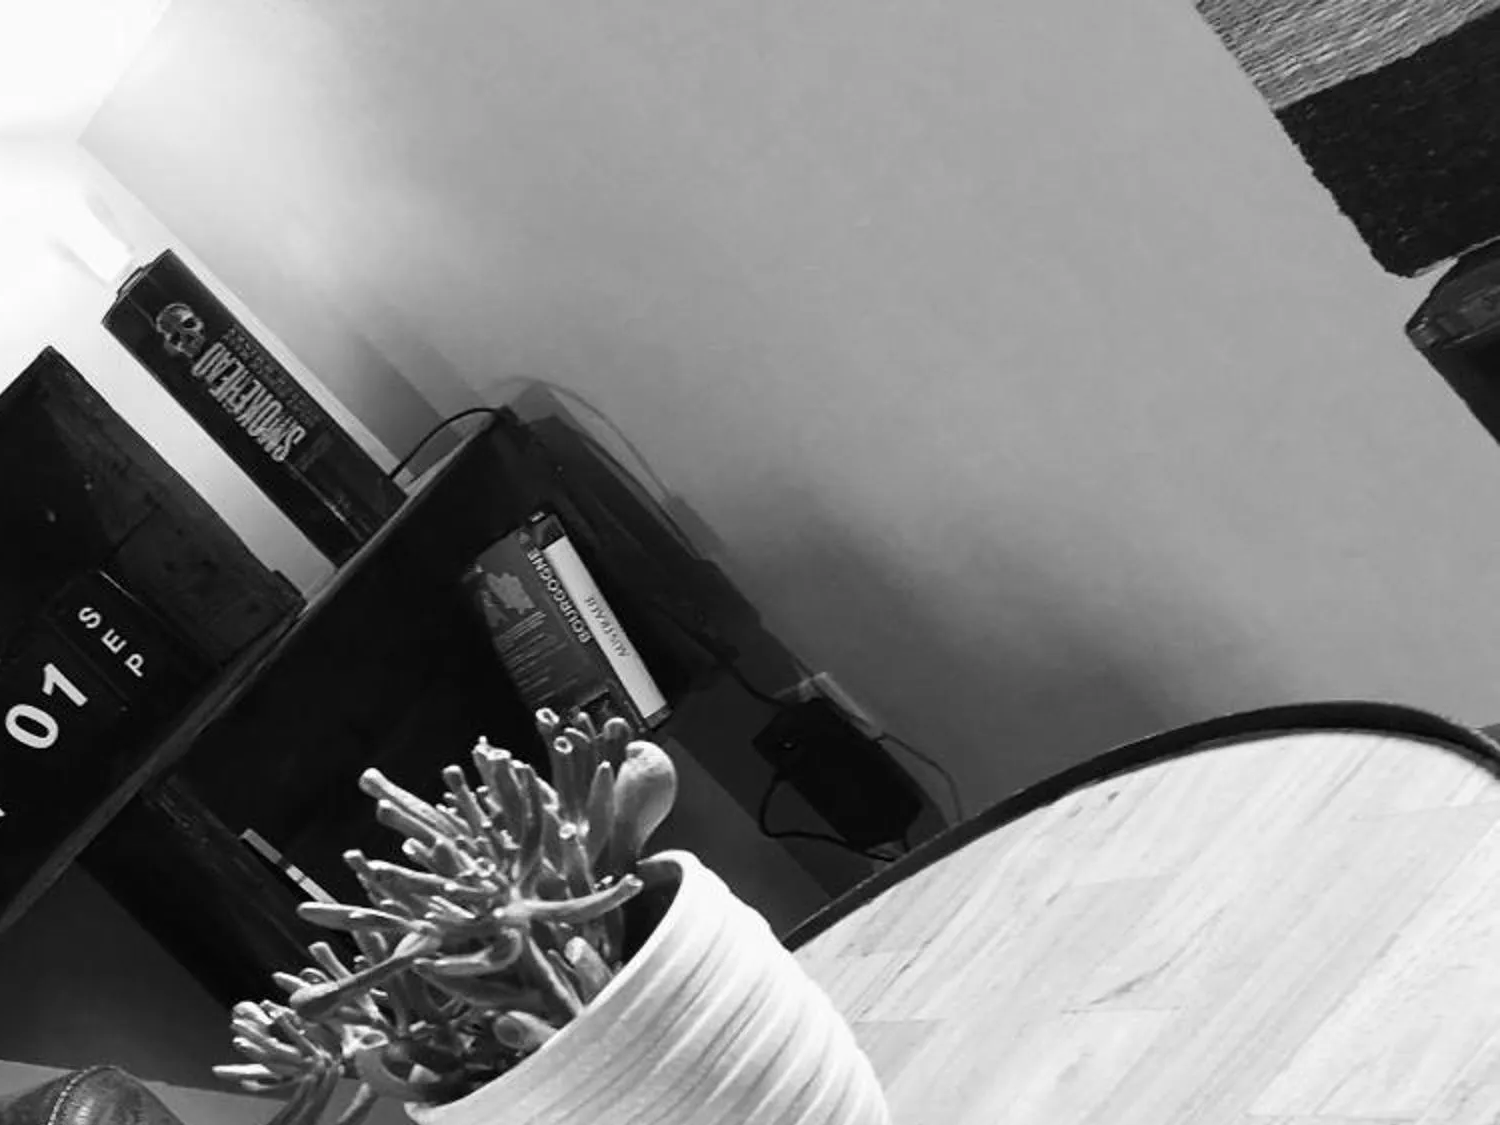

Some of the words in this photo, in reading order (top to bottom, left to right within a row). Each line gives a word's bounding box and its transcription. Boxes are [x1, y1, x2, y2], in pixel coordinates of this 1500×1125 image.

[191, 342, 306, 463] SMOKEHEAD
[527, 548, 592, 643] BOURGOGNE
[4, 663, 88, 749] 01
[78, 606, 143, 677] SEP
